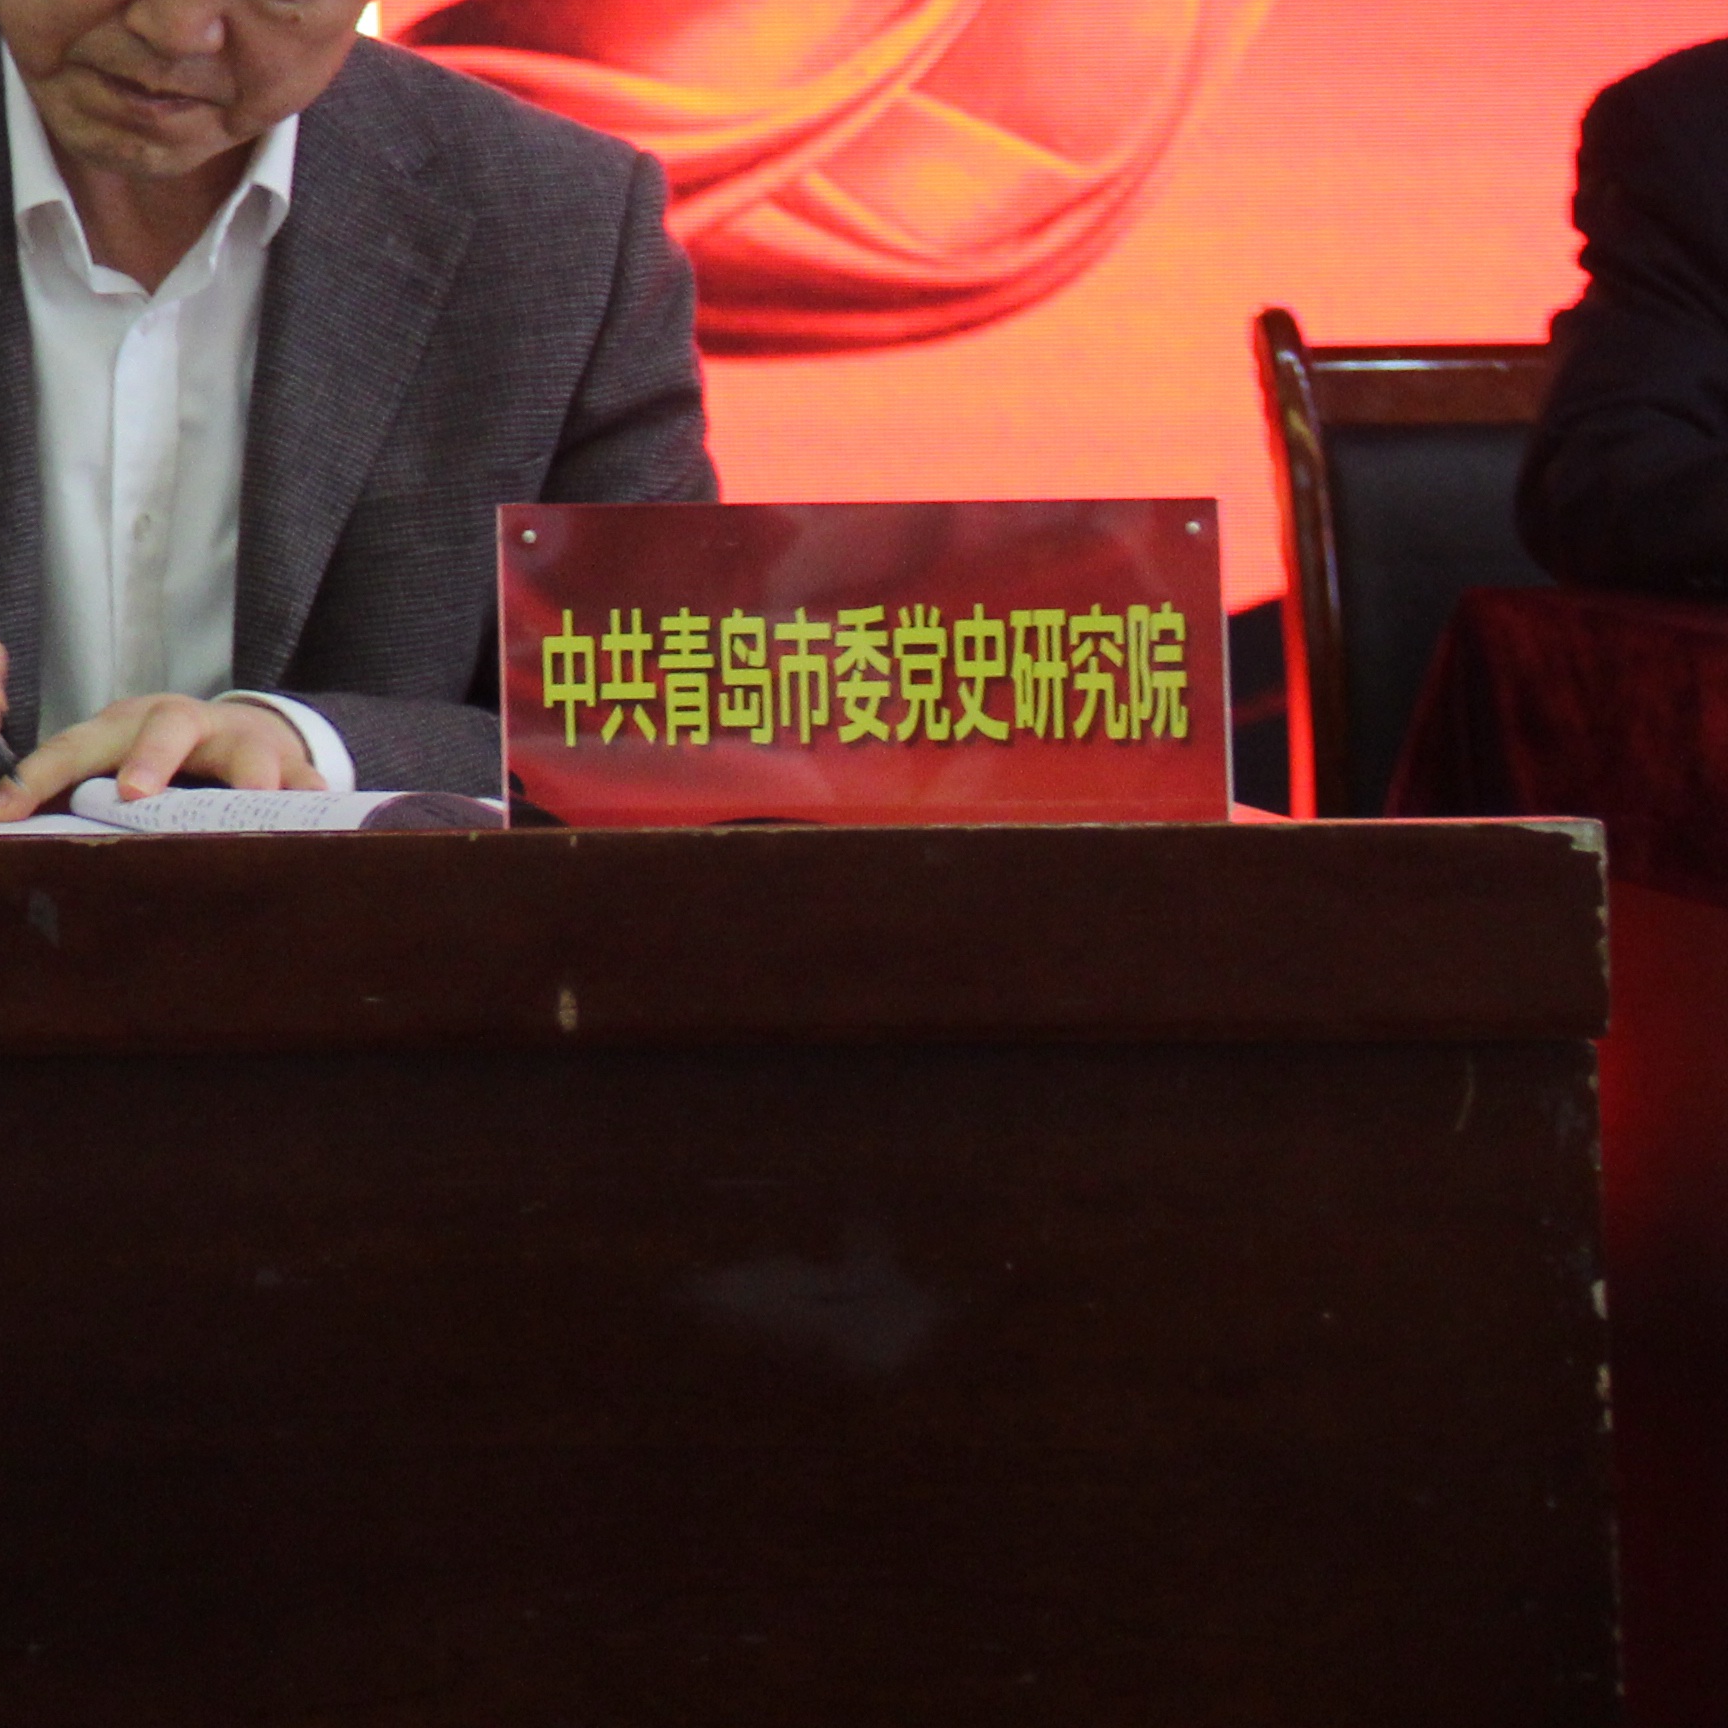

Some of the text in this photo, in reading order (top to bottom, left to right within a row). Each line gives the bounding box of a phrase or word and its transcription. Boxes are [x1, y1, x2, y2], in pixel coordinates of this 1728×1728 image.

[542, 601, 1189, 748] 中共青岛市委党史研究院
